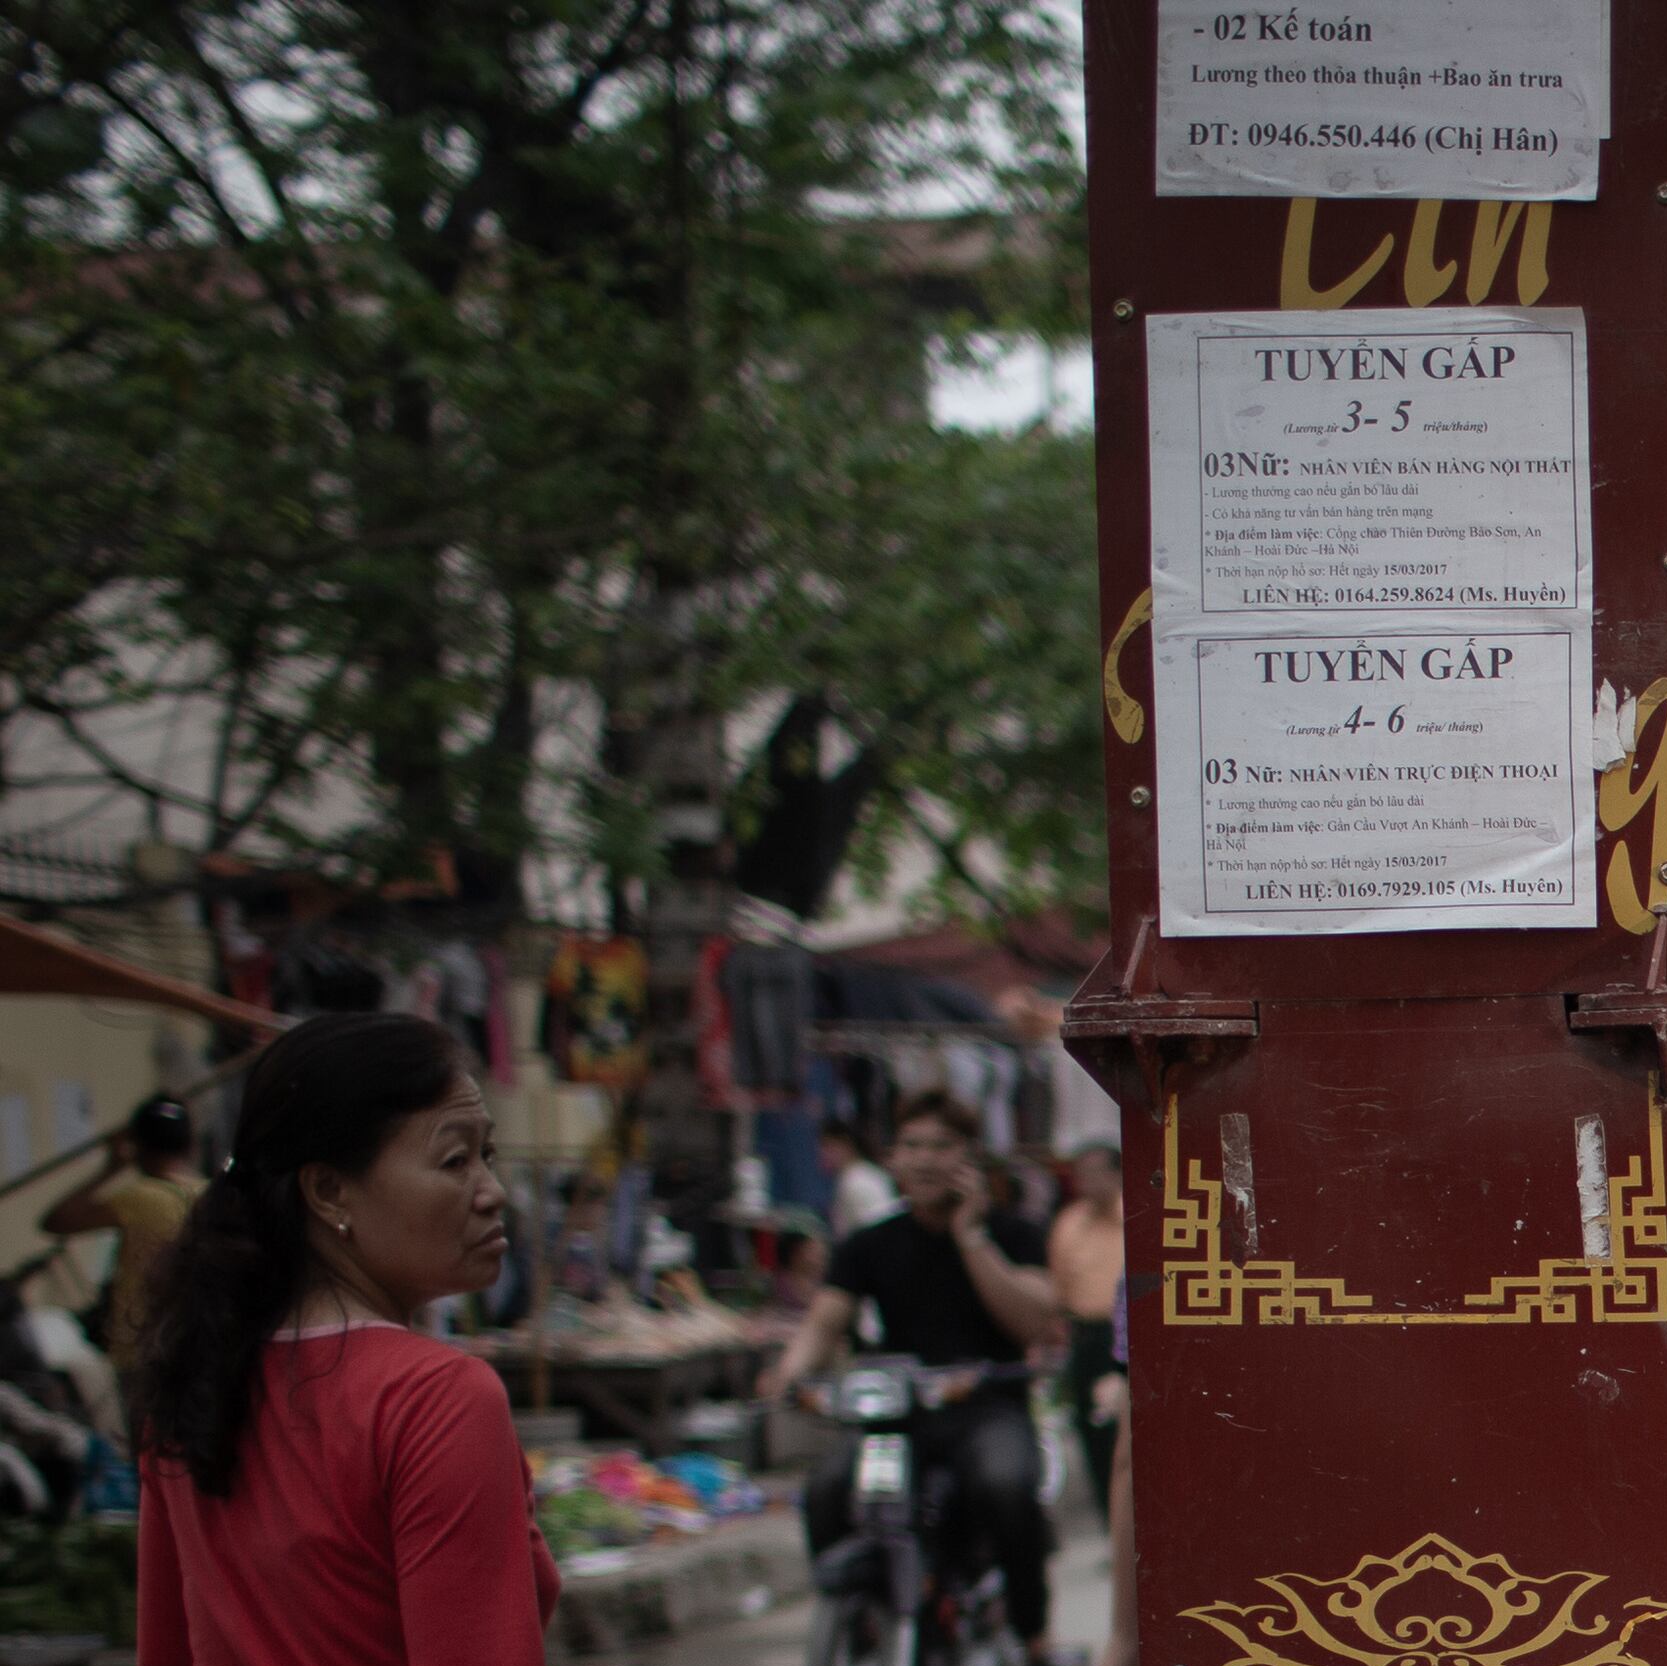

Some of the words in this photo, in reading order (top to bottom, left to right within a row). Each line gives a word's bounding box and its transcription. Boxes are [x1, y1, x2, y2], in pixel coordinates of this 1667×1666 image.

[1213, 15, 1246, 41] 02
[1258, 7, 1300, 42] Kế
[1308, 15, 1372, 42] toán
[1191, 65, 1258, 88] Lương
[1265, 66, 1307, 86] theo
[1363, 66, 1422, 90] thuận
[1488, 70, 1514, 88] ăn
[1519, 71, 1564, 89] trưa
[1188, 124, 1240, 147] ĐT:
[1247, 124, 1417, 150] 0946.550.446
[1425, 125, 1484, 157] (Chị
[1492, 126, 1560, 158] Hân)
[1255, 338, 1408, 382] TUYỂN
[1422, 336, 1515, 379] GẤP
[1300, 459, 1347, 475] NHÂN
[1352, 458, 1392, 475] VIÊN
[1490, 459, 1520, 476] NỘI
[1243, 584, 1289, 604] LIÊN
[1296, 585, 1329, 606] HỆ:
[1335, 586, 1454, 603] 0164.259.8624
[1460, 586, 1497, 604] (Ms.
[1421, 637, 1513, 680] GẤP
[1388, 704, 1406, 734] 6
[1205, 758, 1238, 784] 03
[1246, 765, 1282, 783] Nữ:
[1290, 764, 1340, 782] NHÂN
[1346, 763, 1389, 781] VIÊN
[1499, 763, 1558, 781] THOẠI
[1246, 880, 1292, 900] LIÊN
[1299, 882, 1332, 901] HỆ:
[1338, 880, 1455, 898] 0169.7929.105
[1461, 879, 1496, 897] (Ms.
